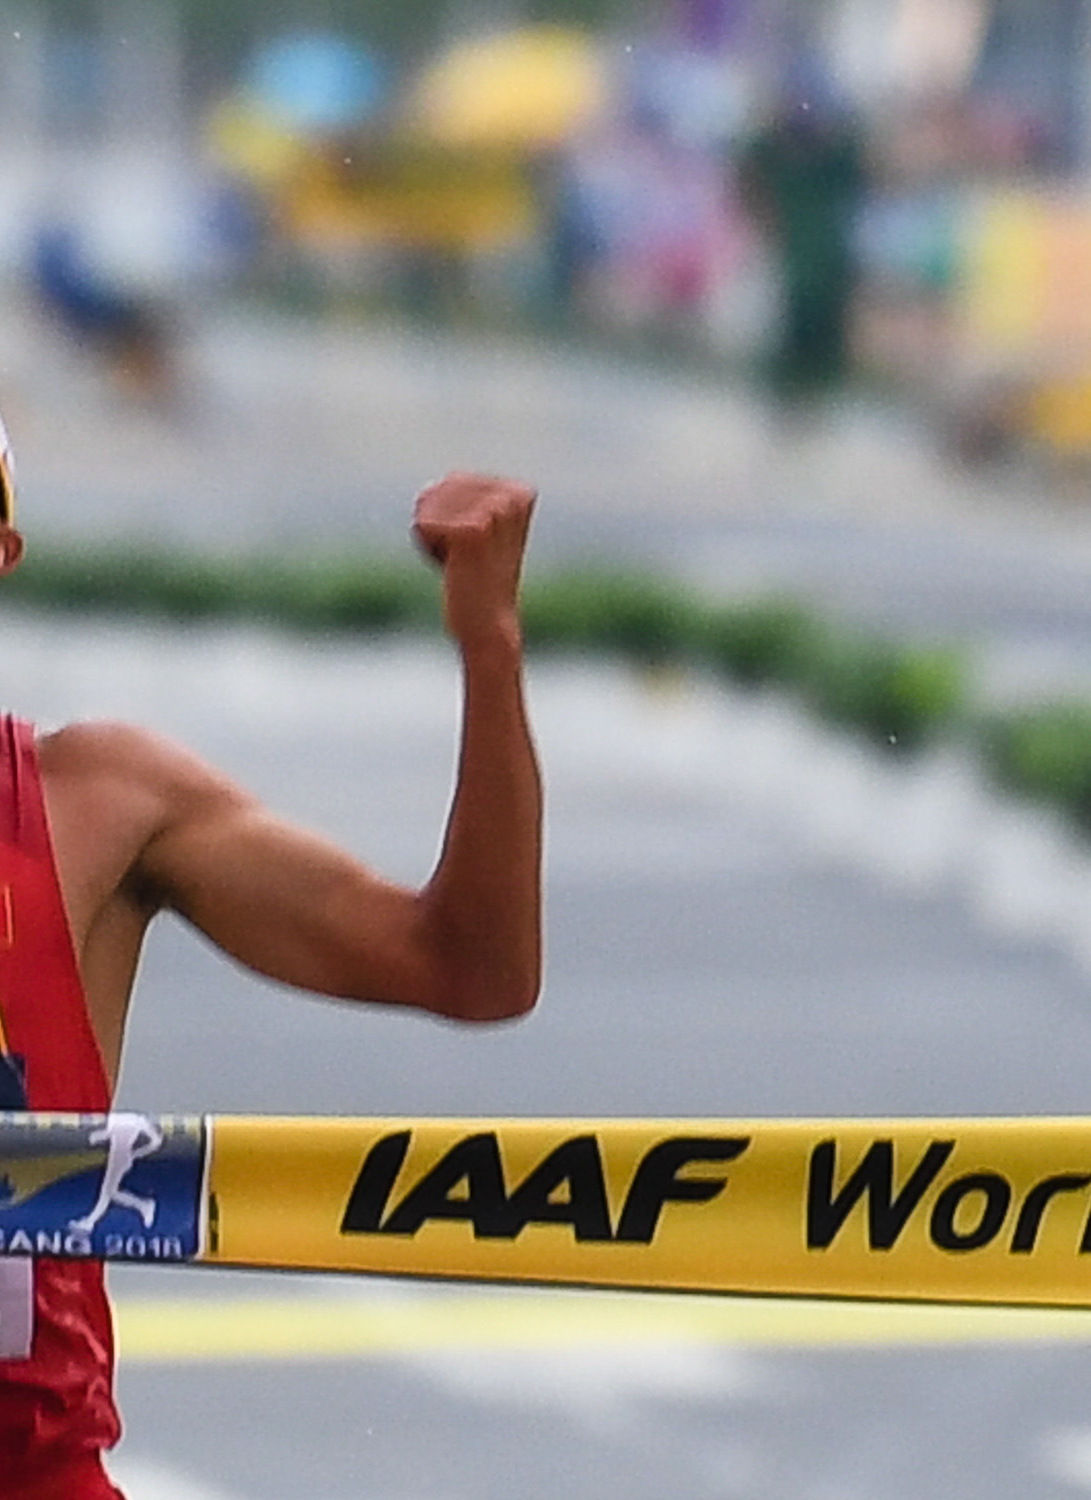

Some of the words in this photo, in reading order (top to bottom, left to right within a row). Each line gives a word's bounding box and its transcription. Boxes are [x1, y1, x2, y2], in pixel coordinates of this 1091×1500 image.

[340, 1129, 751, 1244] IAAF
[806, 1138, 1091, 1256] Wor
[105, 1233, 182, 1259] 2018
